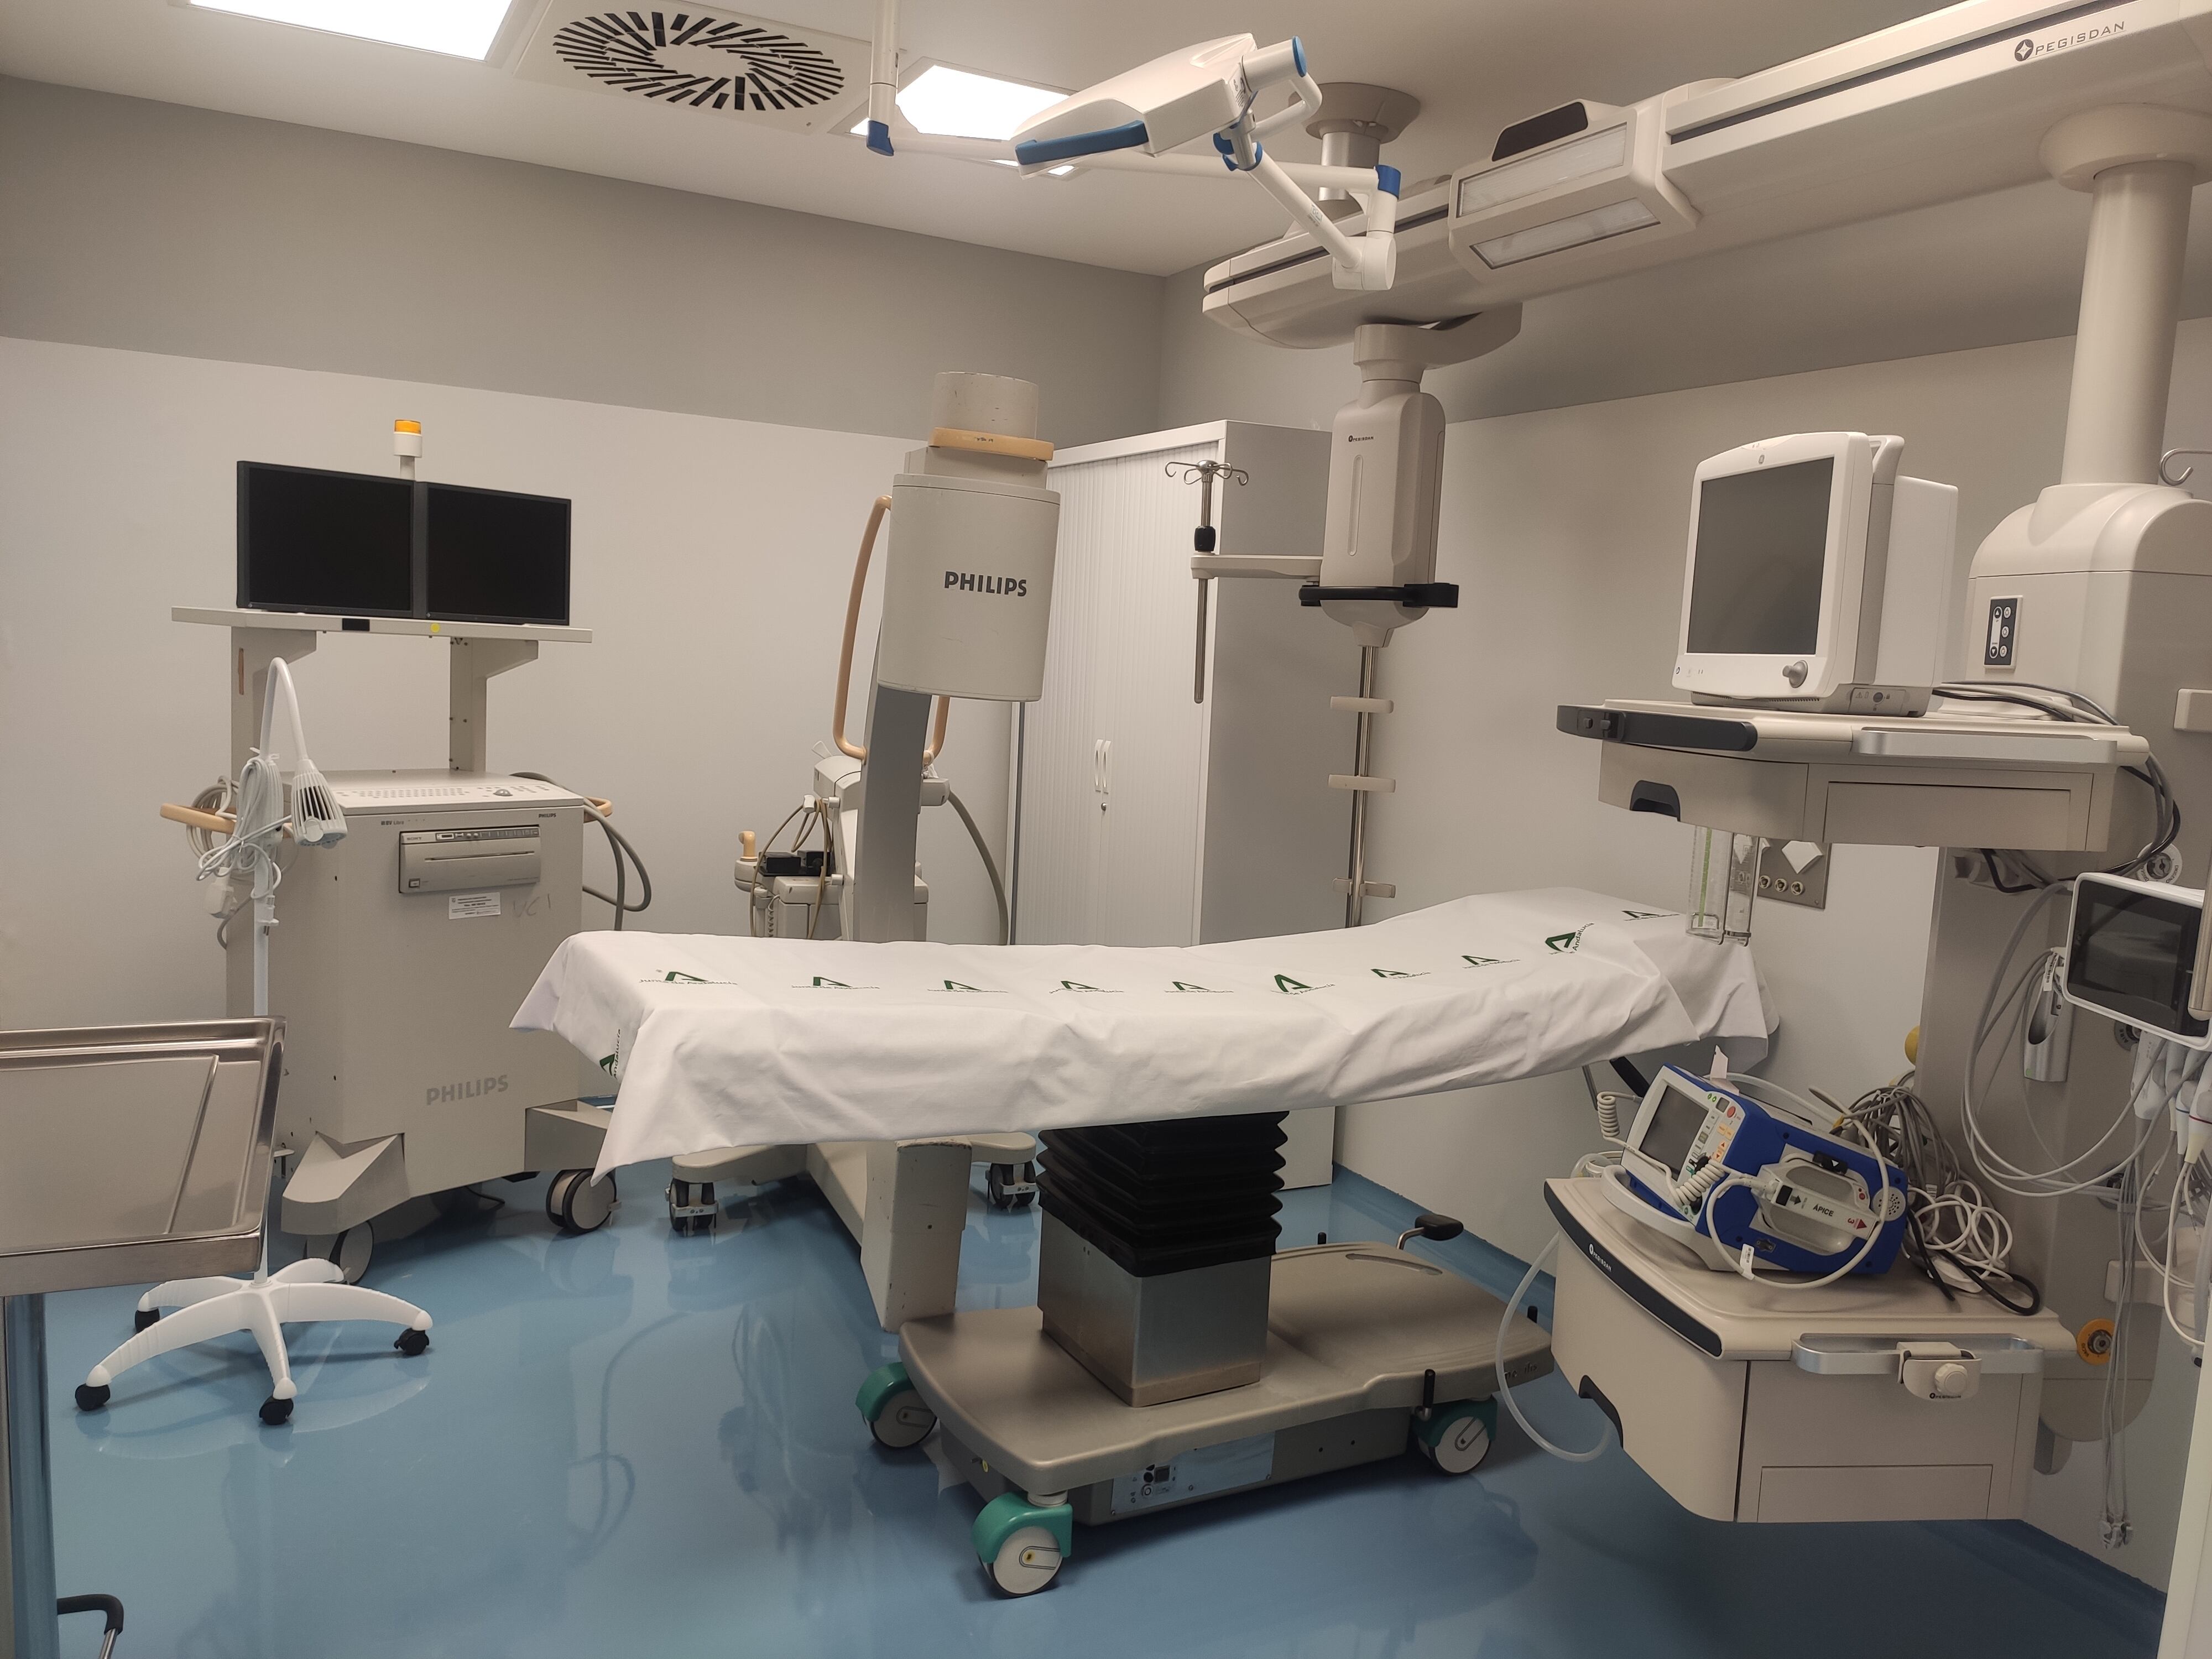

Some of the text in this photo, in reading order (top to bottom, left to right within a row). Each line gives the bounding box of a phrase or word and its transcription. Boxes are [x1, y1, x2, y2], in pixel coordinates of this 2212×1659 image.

[2035, 21, 2125, 56] PEGISDAN
[944, 571, 1027, 597] PHILIPS
[426, 1074, 509, 1106] PHILIPS
